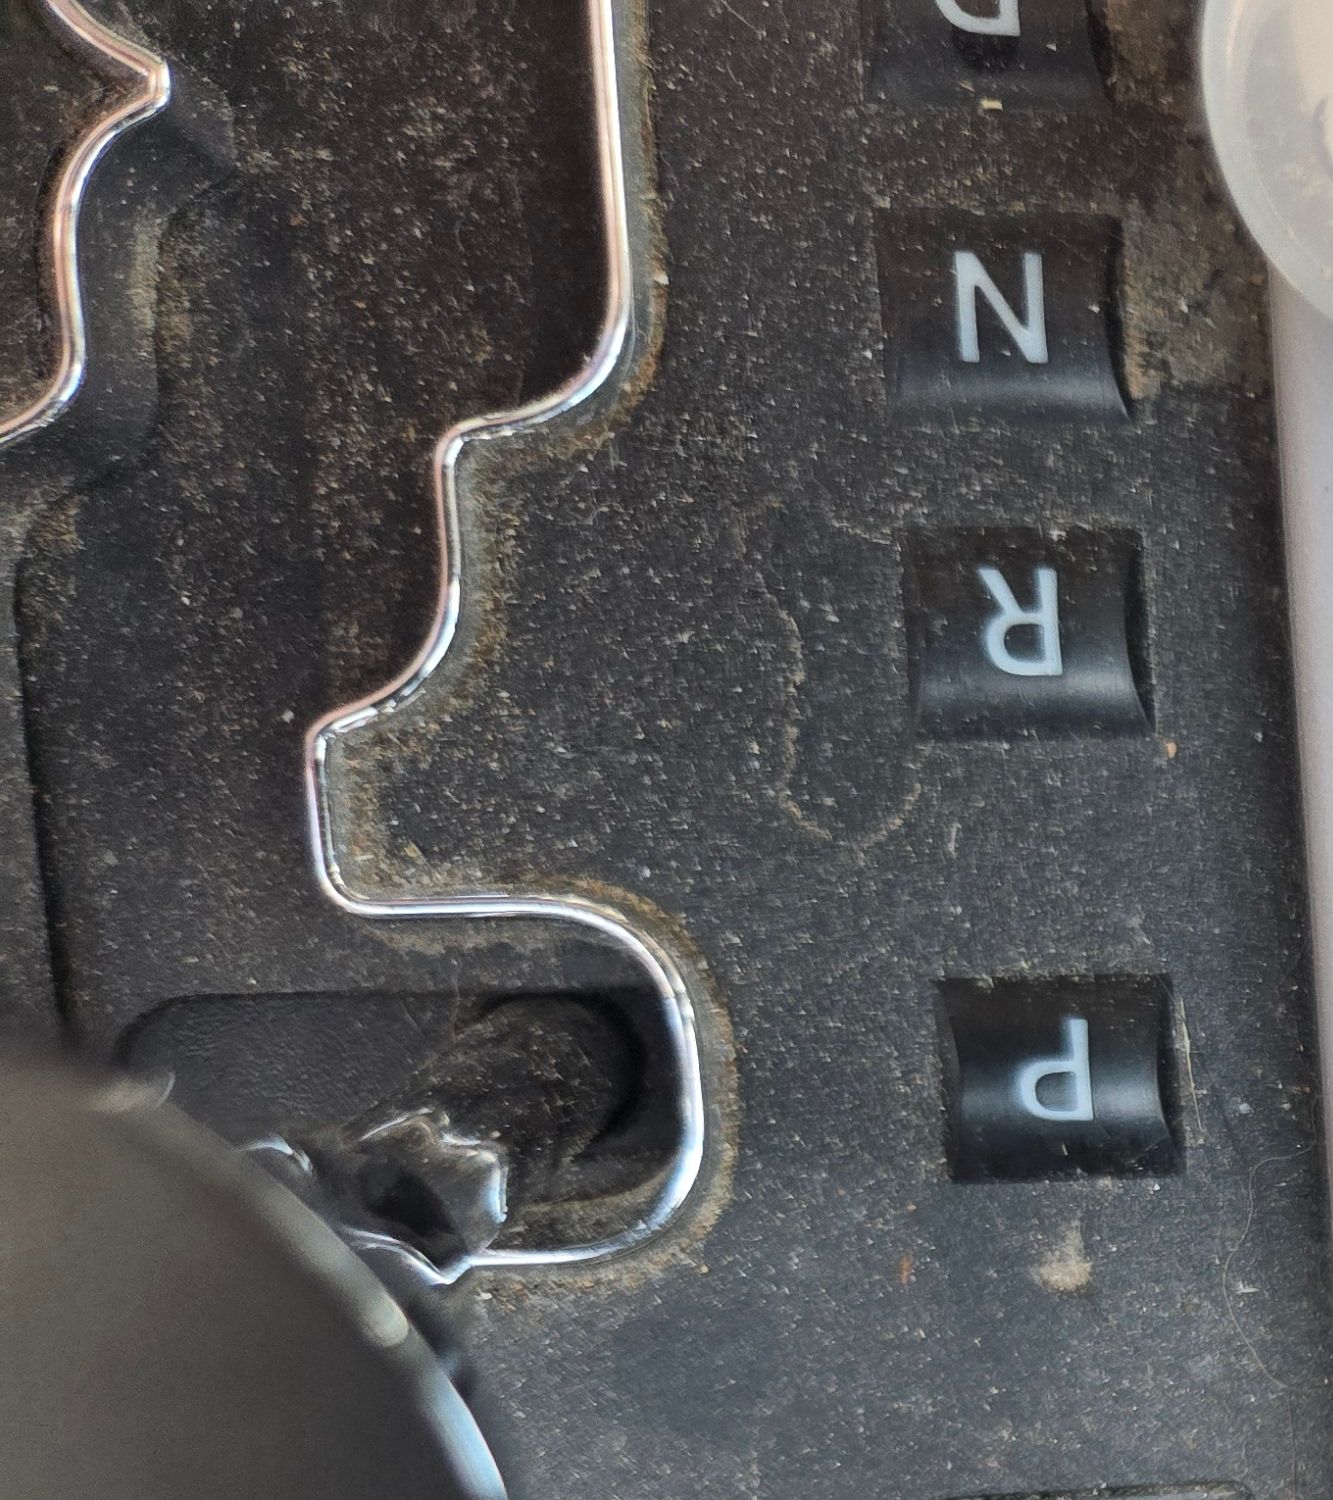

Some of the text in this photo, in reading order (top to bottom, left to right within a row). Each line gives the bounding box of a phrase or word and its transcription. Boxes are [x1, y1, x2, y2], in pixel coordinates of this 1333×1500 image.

[953, 251, 1049, 364] N
[978, 567, 1064, 676] R
[1018, 1018, 1094, 1121] P
